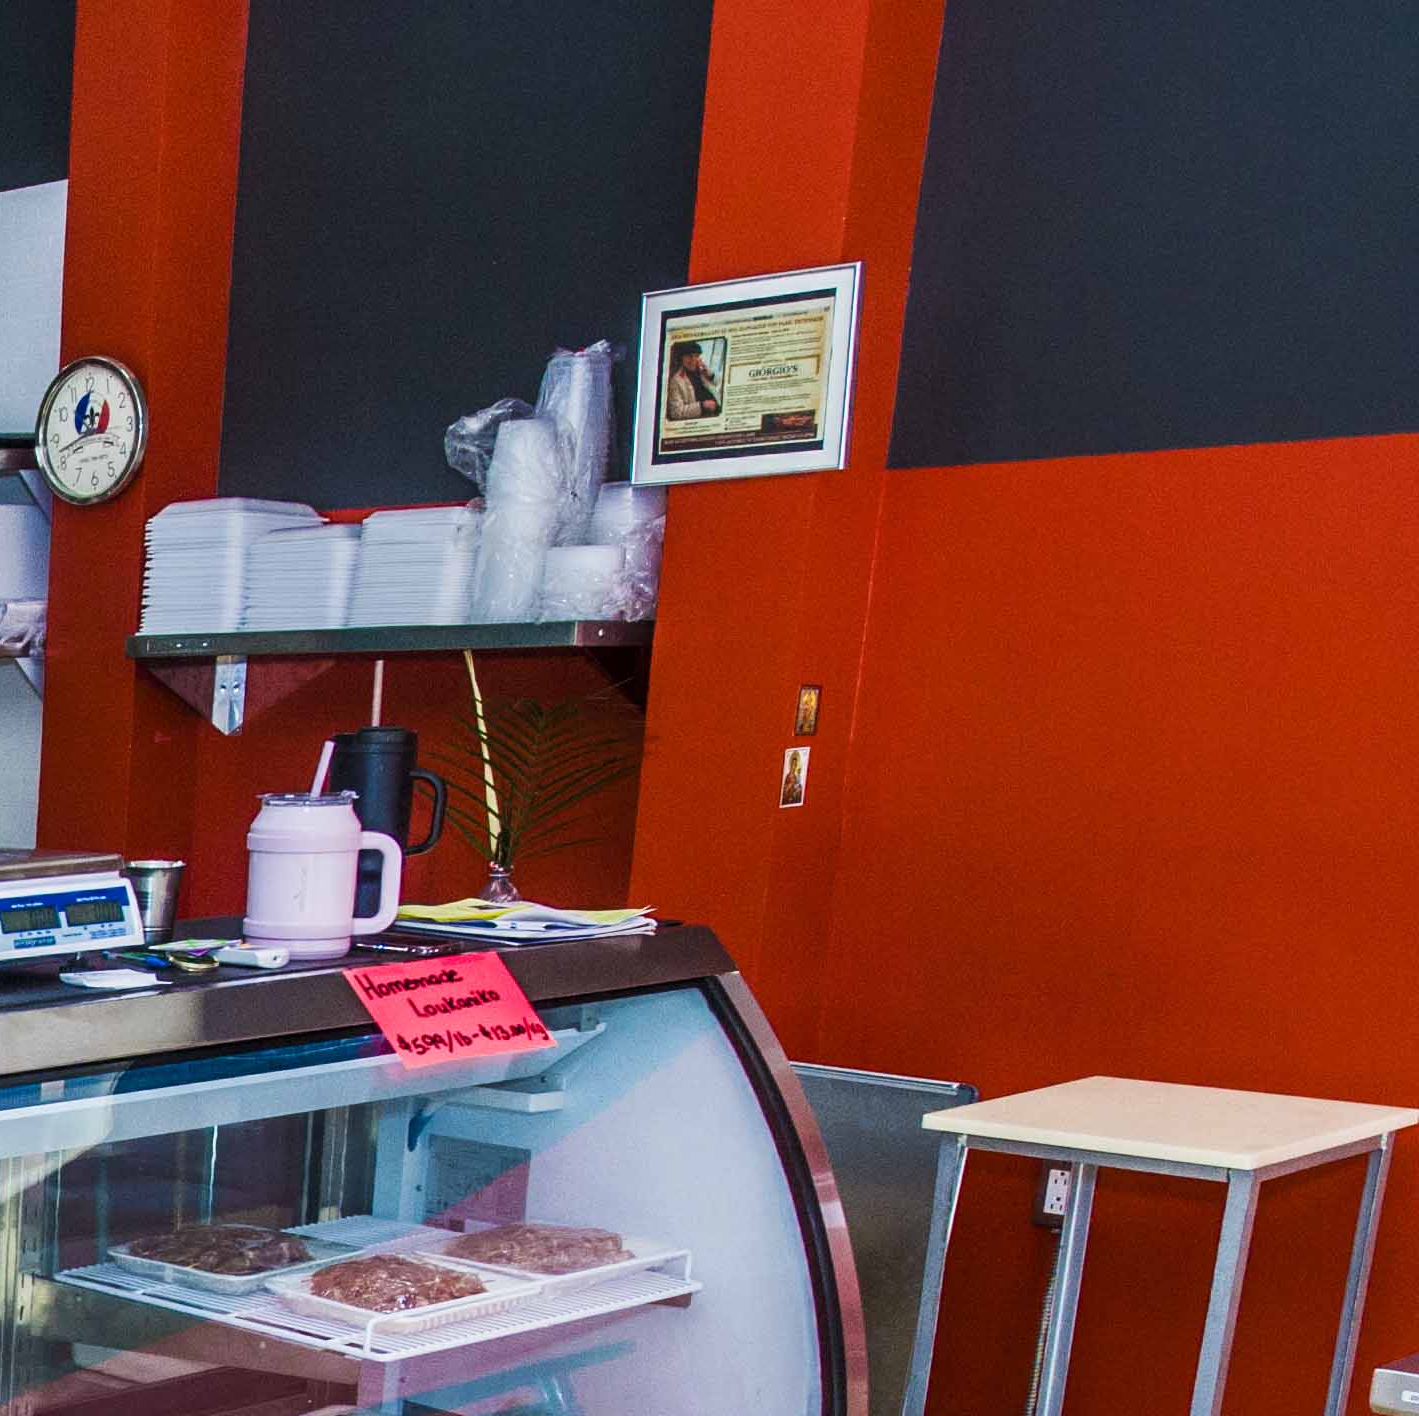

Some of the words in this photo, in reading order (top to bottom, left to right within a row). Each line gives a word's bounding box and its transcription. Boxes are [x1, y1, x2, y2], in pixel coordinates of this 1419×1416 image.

[86, 376, 95, 393] 12
[118, 392, 126, 408] 2
[59, 406, 69, 422] 10
[126, 415, 134, 432] 3
[119, 442, 127, 458] 4
[59, 455, 68, 471] 8
[107, 461, 116, 478] 5
[75, 467, 83, 483] 7
[91, 471, 100, 486] 6
[354, 968, 464, 1001] Homemade
[407, 989, 501, 1018] Loukaniko
